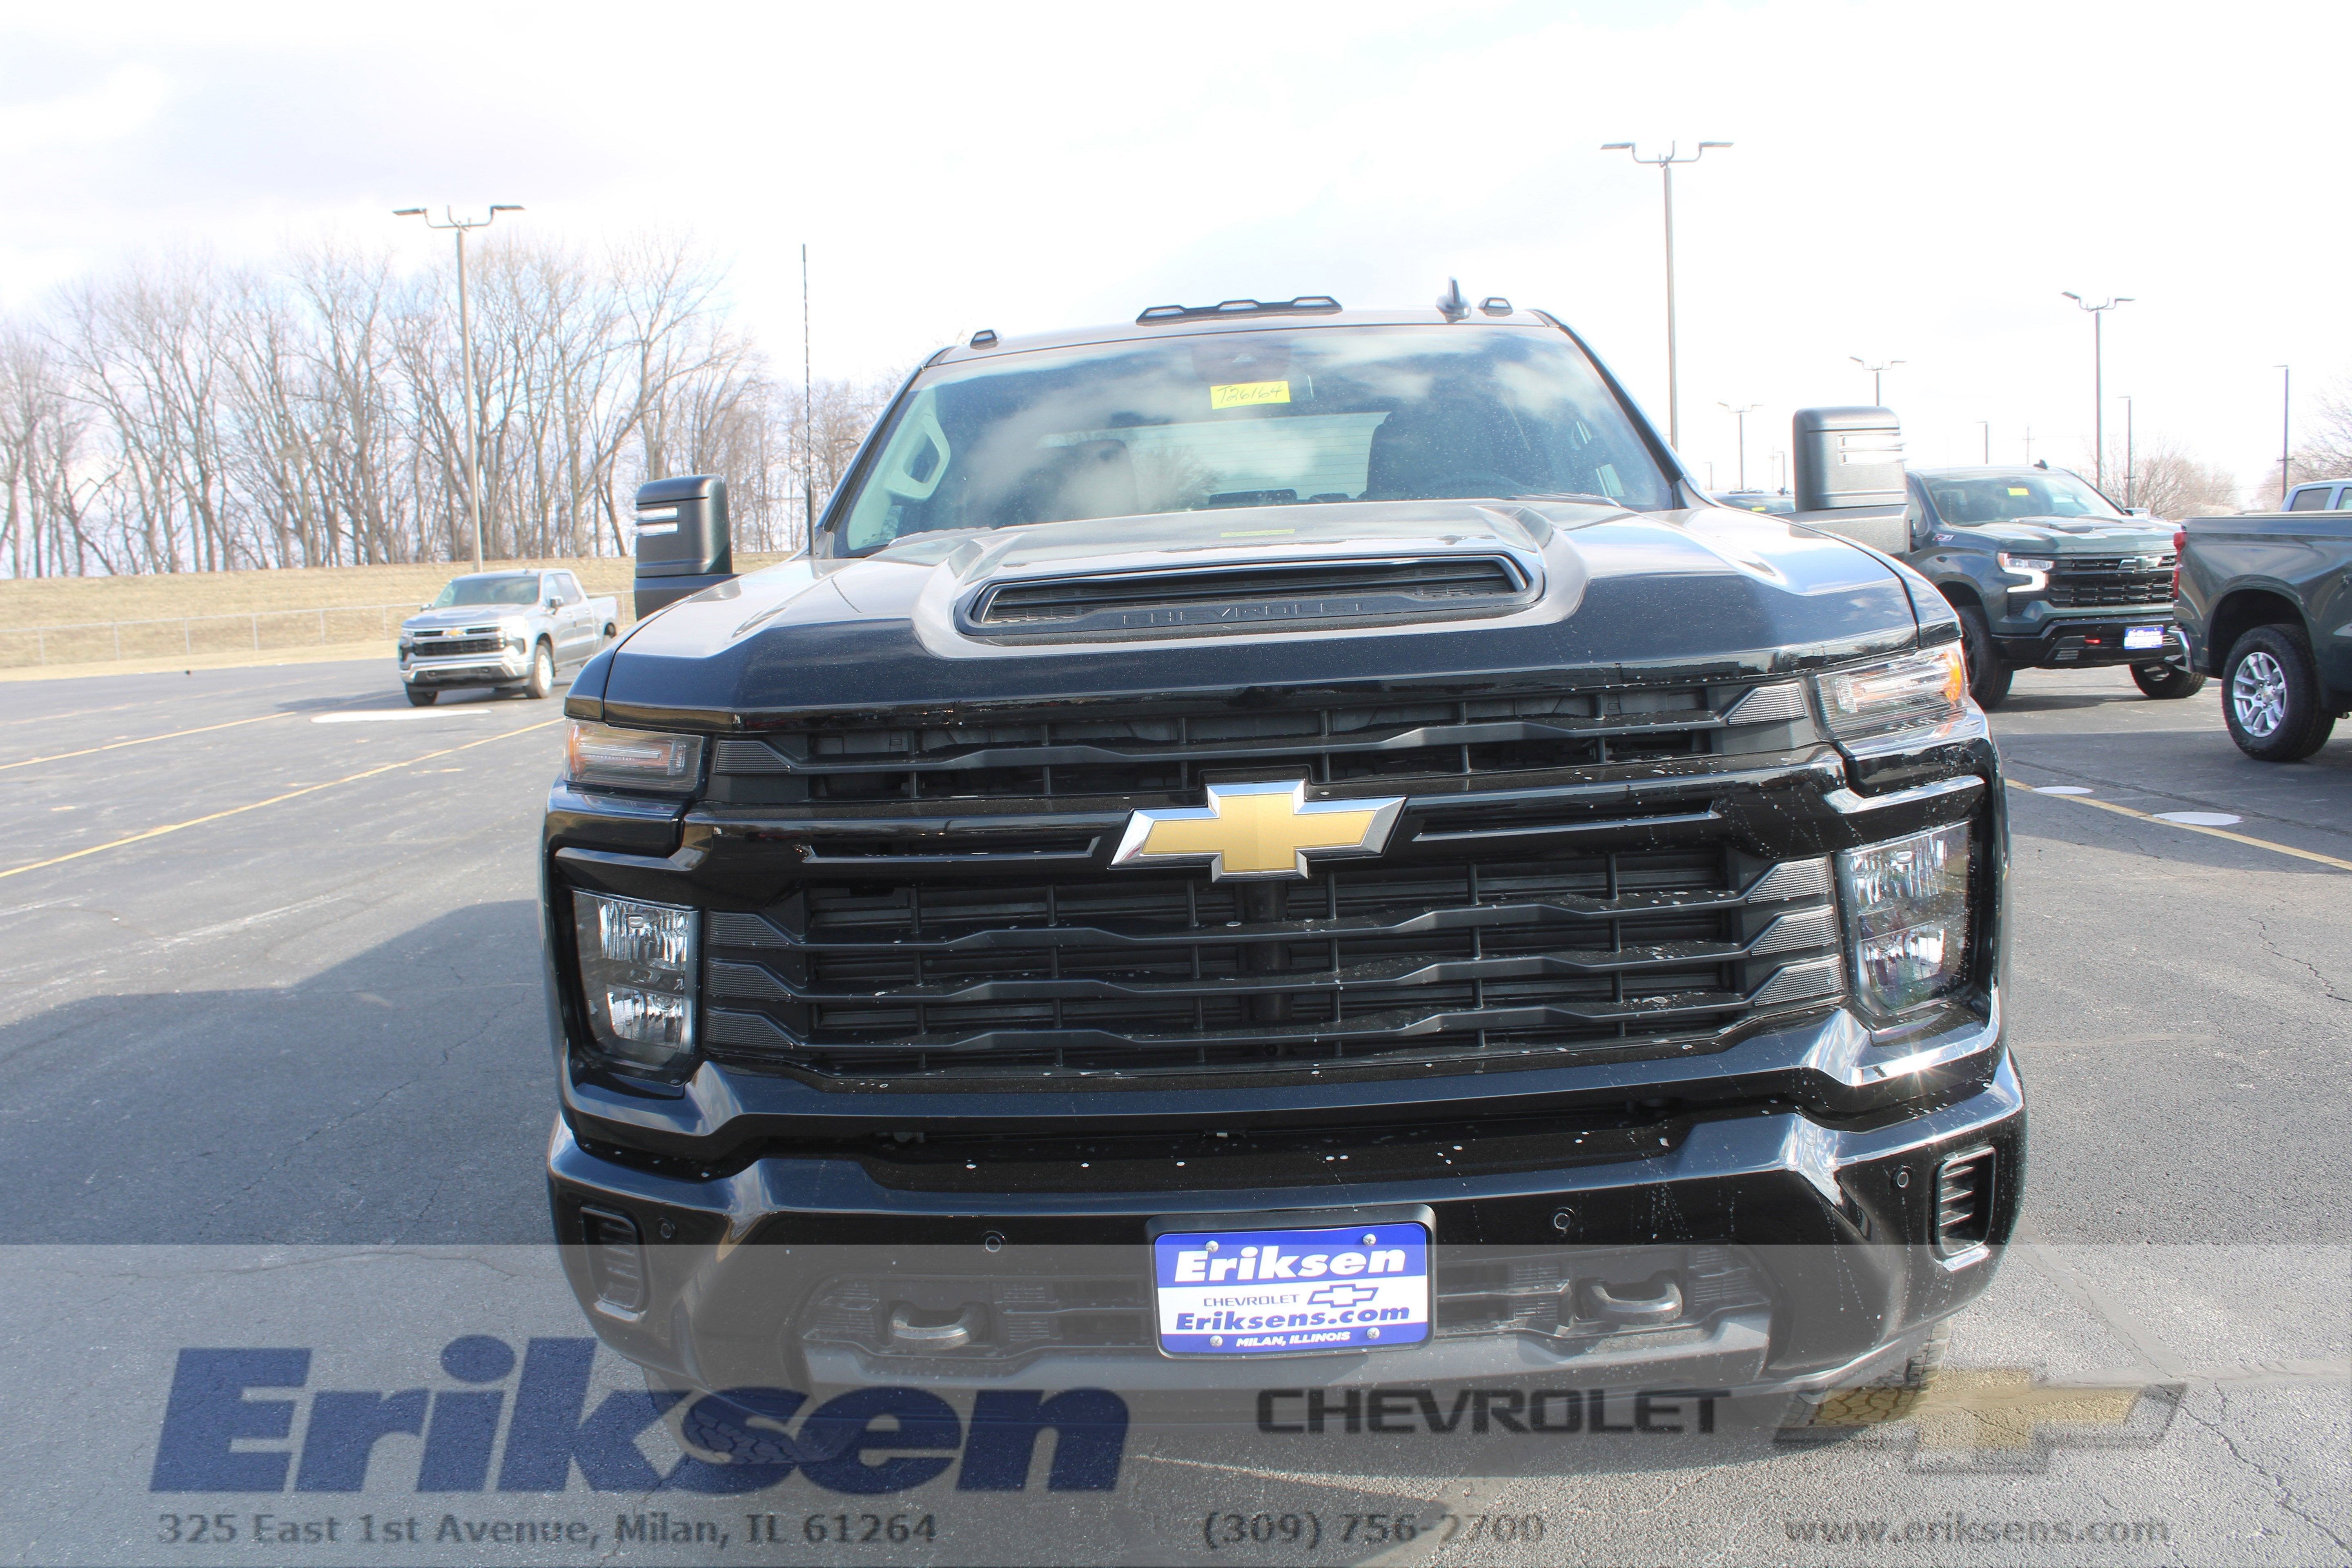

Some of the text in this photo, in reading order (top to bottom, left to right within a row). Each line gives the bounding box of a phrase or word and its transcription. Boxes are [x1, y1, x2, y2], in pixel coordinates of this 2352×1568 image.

[1217, 383, 1283, 403] T26164
[1124, 601, 1372, 625] CHEVROLET
[1174, 1245, 1406, 1282] Eriksen
[1204, 1294, 1300, 1307] CHEVROLET
[1176, 1307, 1410, 1330] Eriksens.com
[1236, 1331, 1351, 1347] MILAN, ILLINOIS
